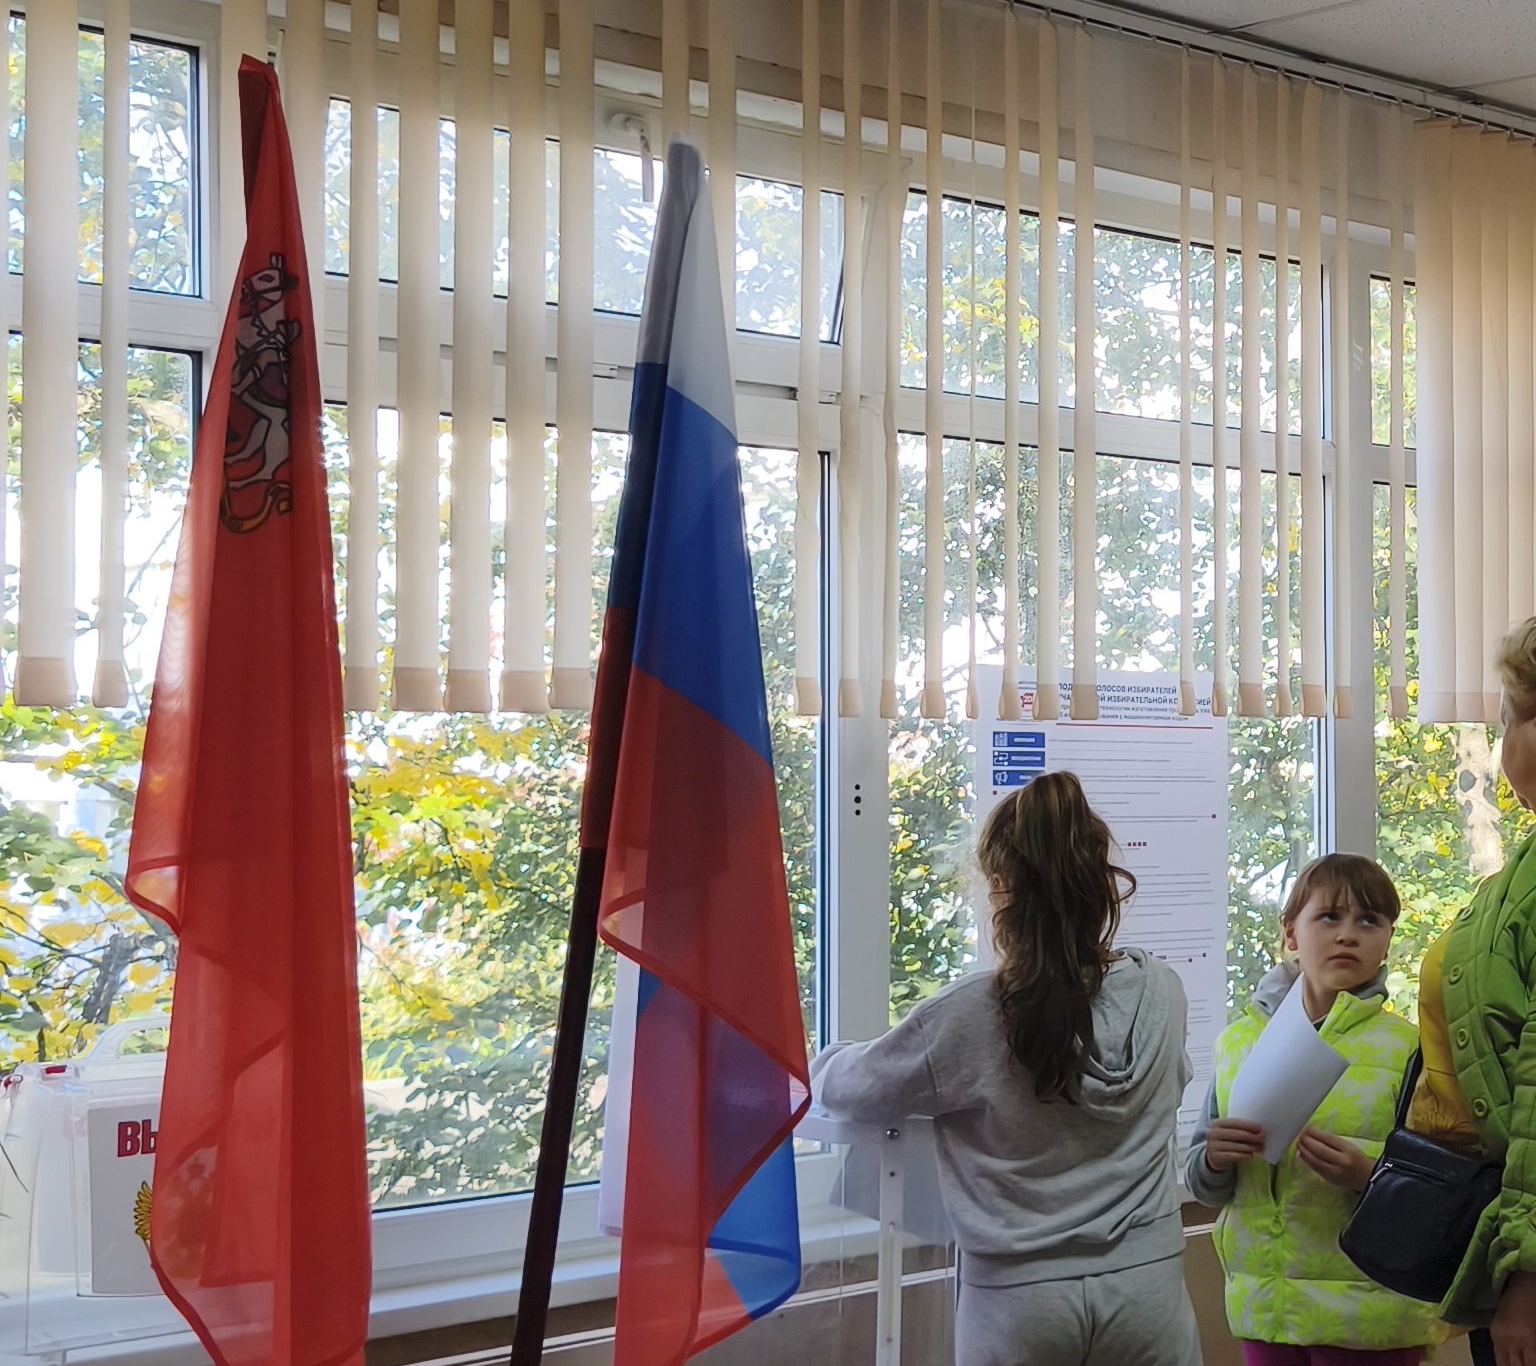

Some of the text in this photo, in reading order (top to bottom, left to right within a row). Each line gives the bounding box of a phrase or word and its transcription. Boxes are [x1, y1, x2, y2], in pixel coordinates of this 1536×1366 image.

[1096, 684, 1126, 693] ОЛОСОВ
[1127, 685, 1177, 695] ИЗБИРАТЕЛЕЙ
[1107, 695, 1168, 704] ИЗБИРАТЕЛЬНОЙ
